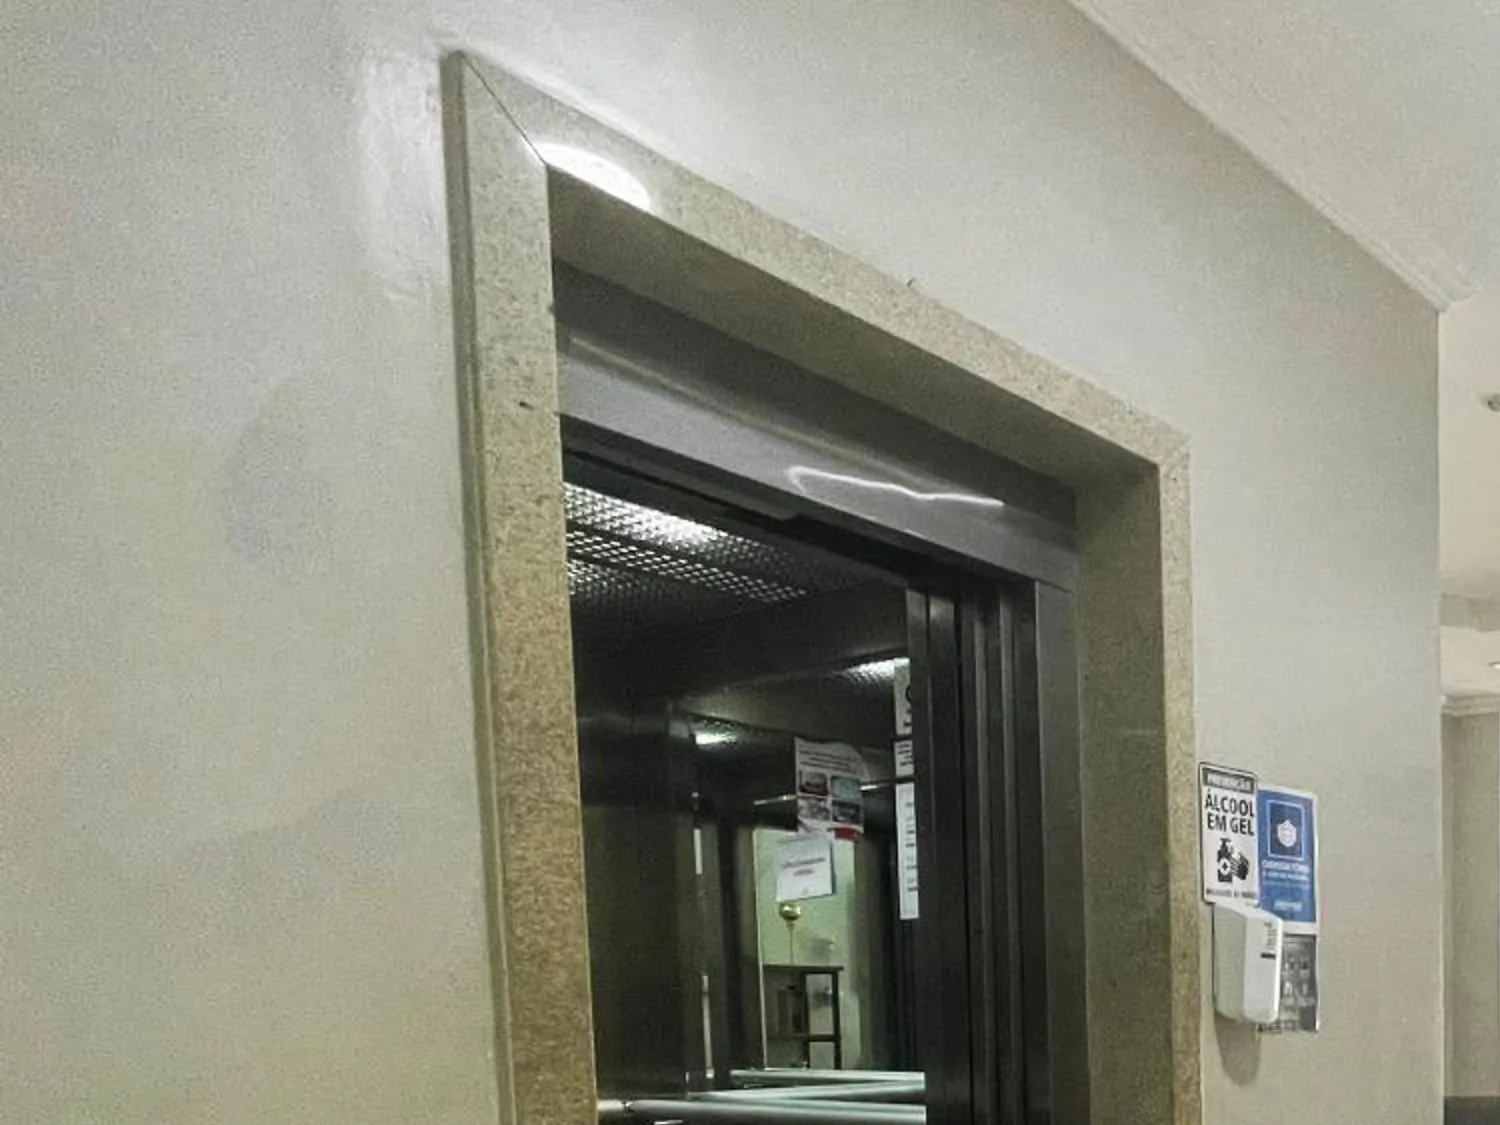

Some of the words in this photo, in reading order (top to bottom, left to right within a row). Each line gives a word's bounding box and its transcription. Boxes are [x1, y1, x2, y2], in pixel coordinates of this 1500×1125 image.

[1204, 788, 1255, 817] ÁLCOOL
[1208, 812, 1226, 832] EM
[1230, 818, 1254, 836] GEL
